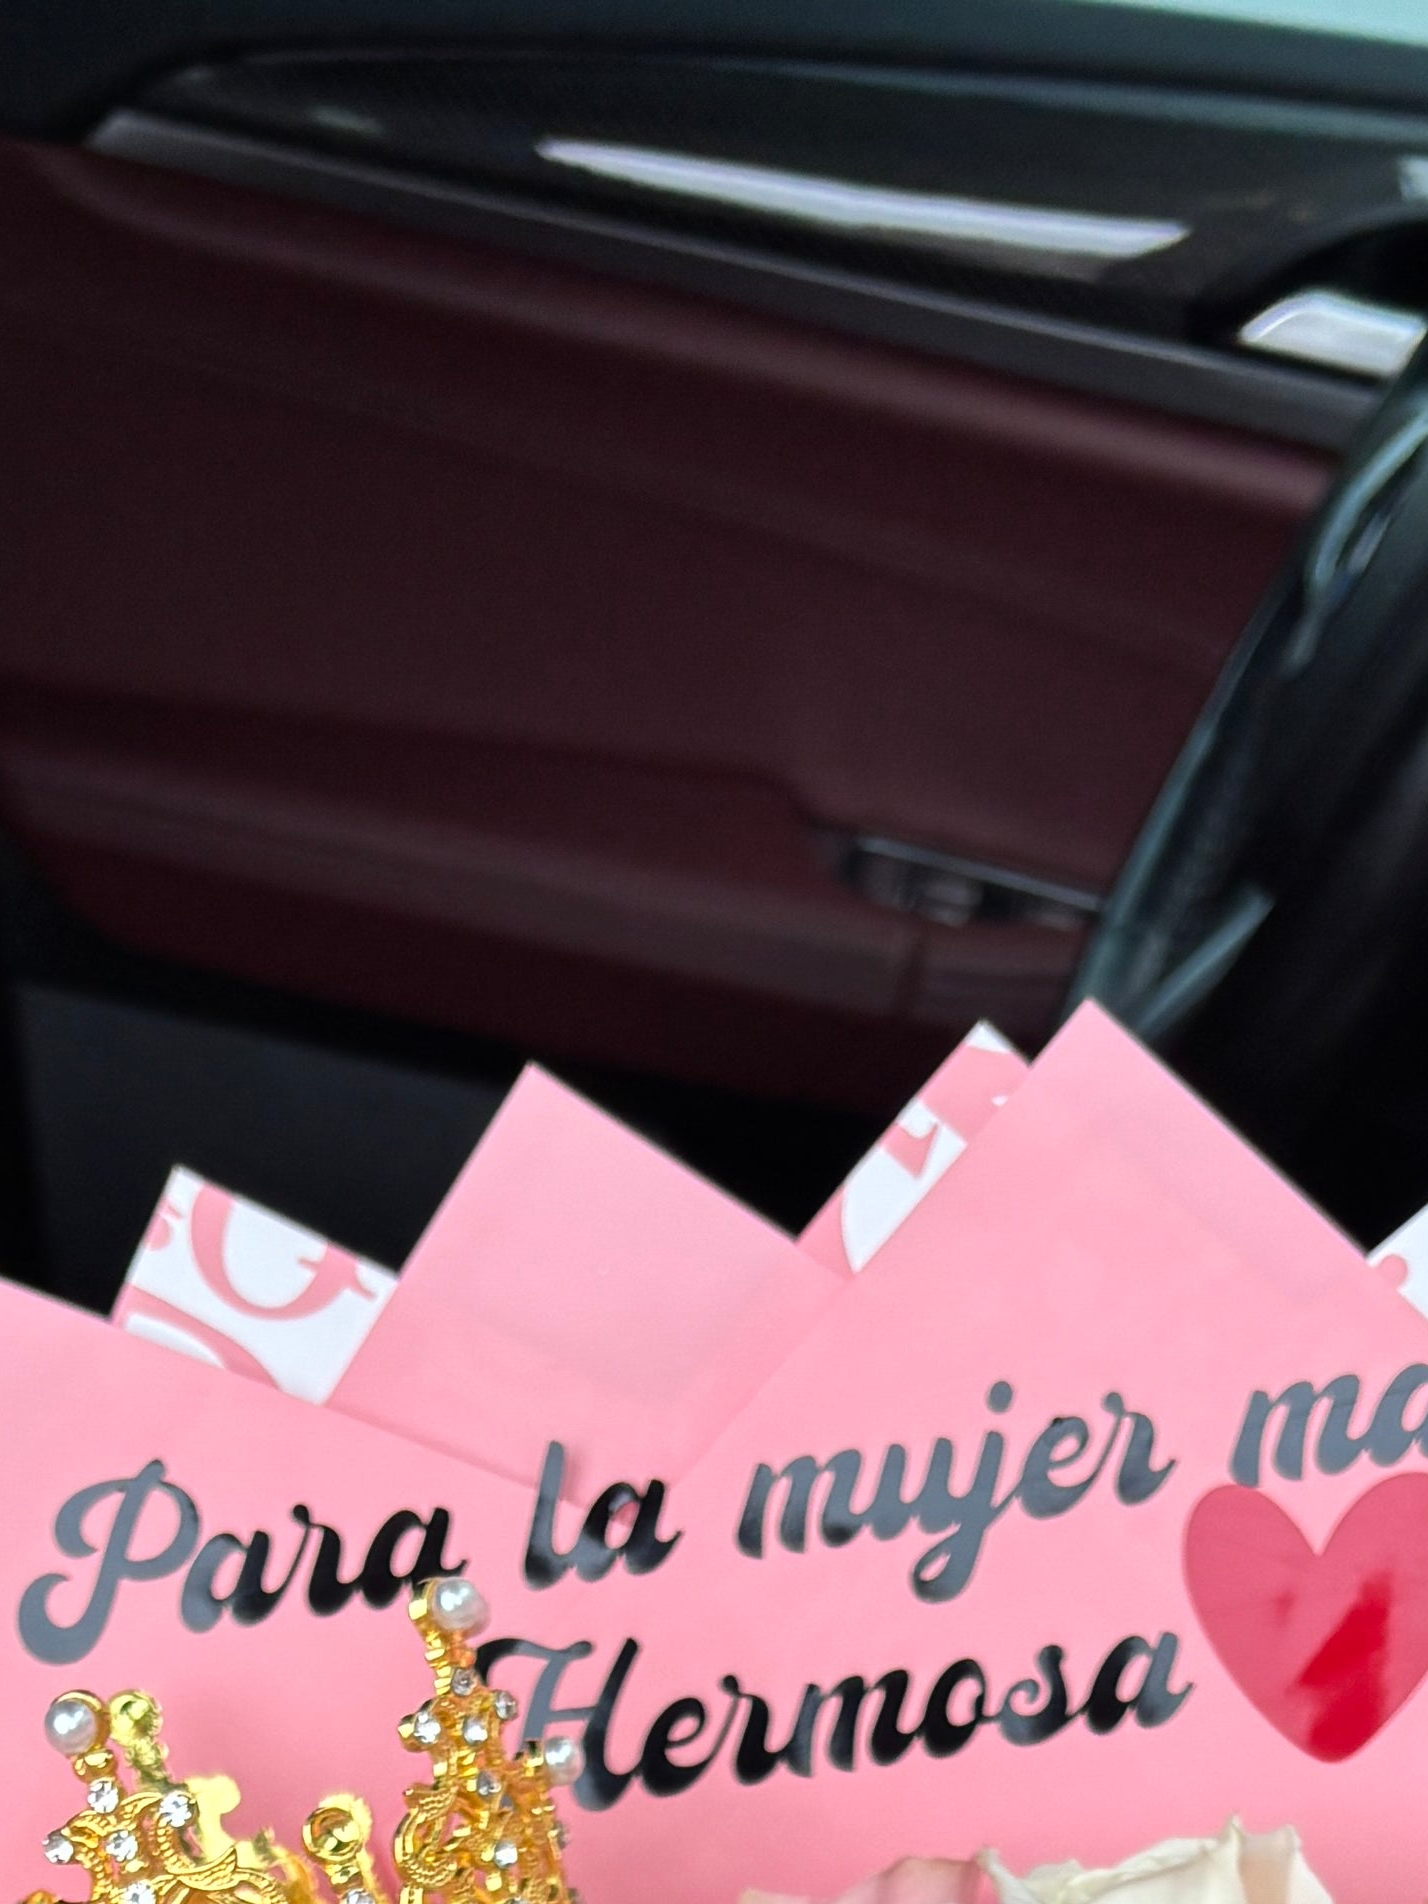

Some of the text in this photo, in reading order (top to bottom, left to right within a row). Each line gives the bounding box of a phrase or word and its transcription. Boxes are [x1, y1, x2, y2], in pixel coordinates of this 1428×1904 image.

[17, 1457, 470, 1666] Para
[521, 1439, 684, 1591] la
[734, 1379, 1177, 1605] mujer
[469, 1630, 1195, 1814] Hermosa
